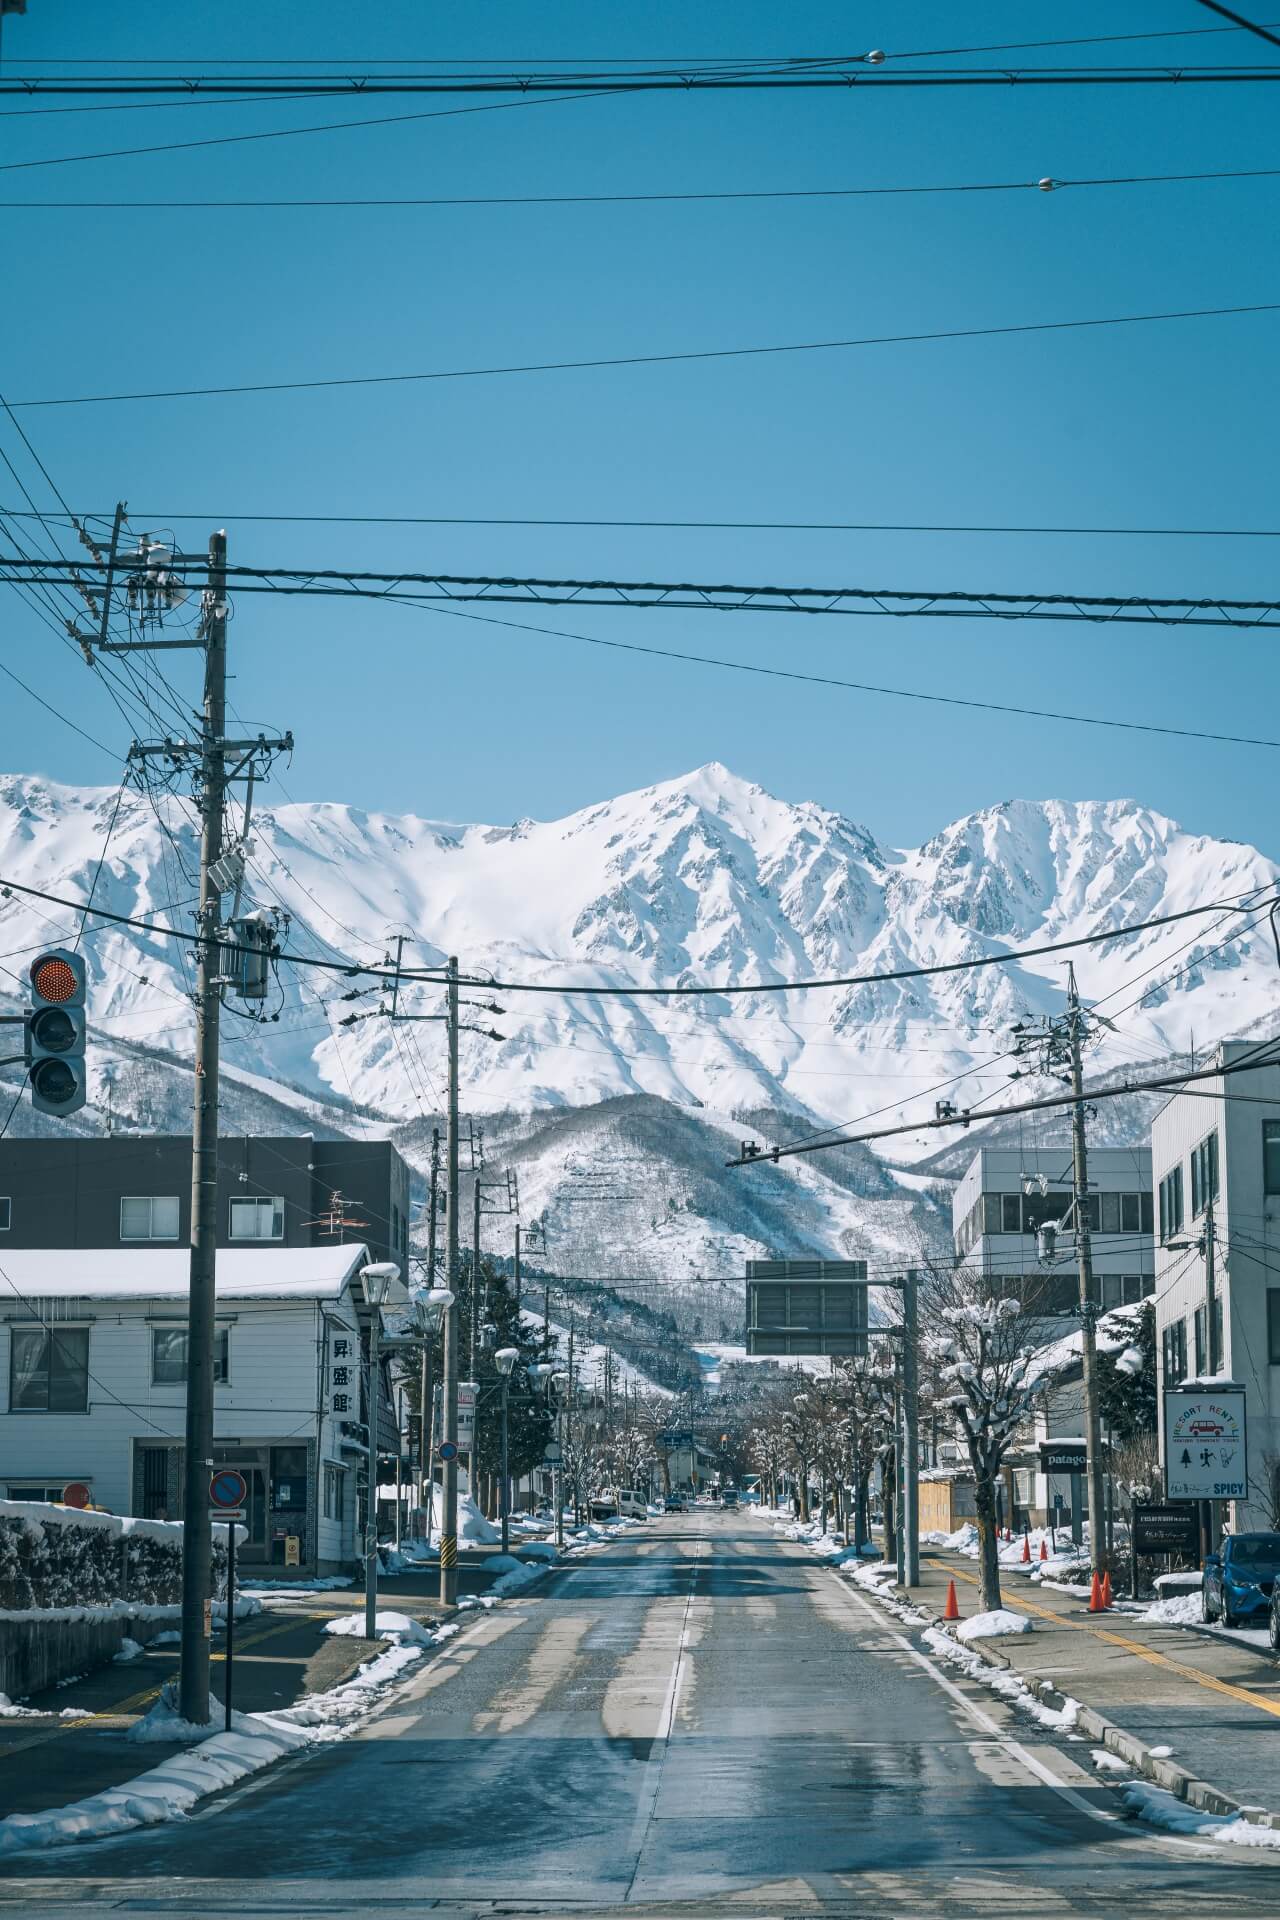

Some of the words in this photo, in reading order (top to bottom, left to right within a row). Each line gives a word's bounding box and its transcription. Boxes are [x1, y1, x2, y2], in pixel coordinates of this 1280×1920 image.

[333, 1340, 348, 1412] 昇盛館
[1173, 1405, 1202, 1435] RESORT
[1208, 1405, 1239, 1436] RENTAL
[1048, 1455, 1086, 1466] patago
[1213, 1483, 1244, 1495] SPICY
